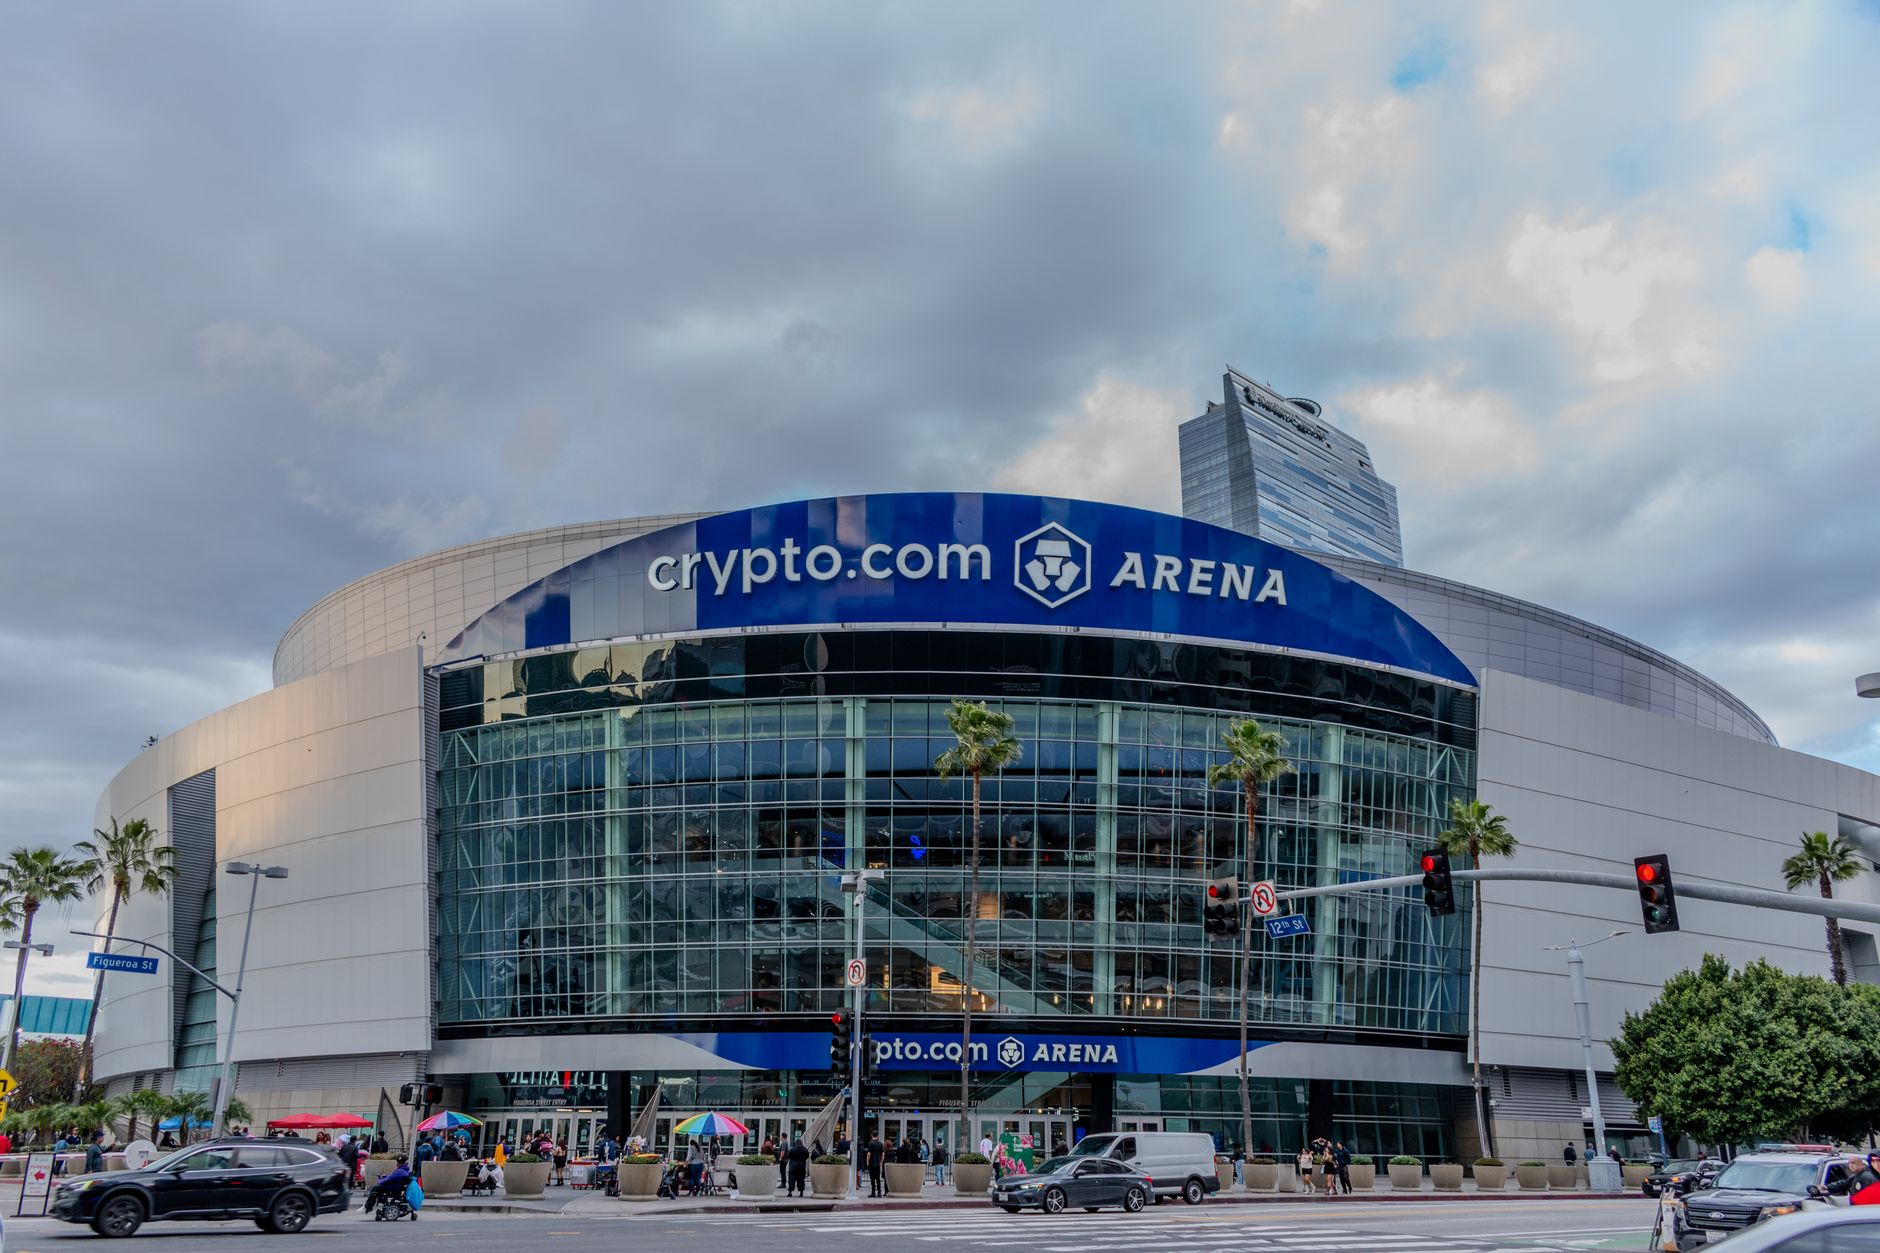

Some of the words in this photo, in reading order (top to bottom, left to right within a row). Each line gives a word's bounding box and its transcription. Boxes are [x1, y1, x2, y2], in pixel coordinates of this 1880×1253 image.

[647, 537, 992, 597] crypto.com
[1109, 551, 1287, 606] ARENA
[1270, 920, 1290, 935] 12th
[1292, 919, 1305, 930] St
[93, 955, 138, 969] Figueroa
[141, 960, 153, 970] St
[1031, 1043, 1118, 1064] ARENA
